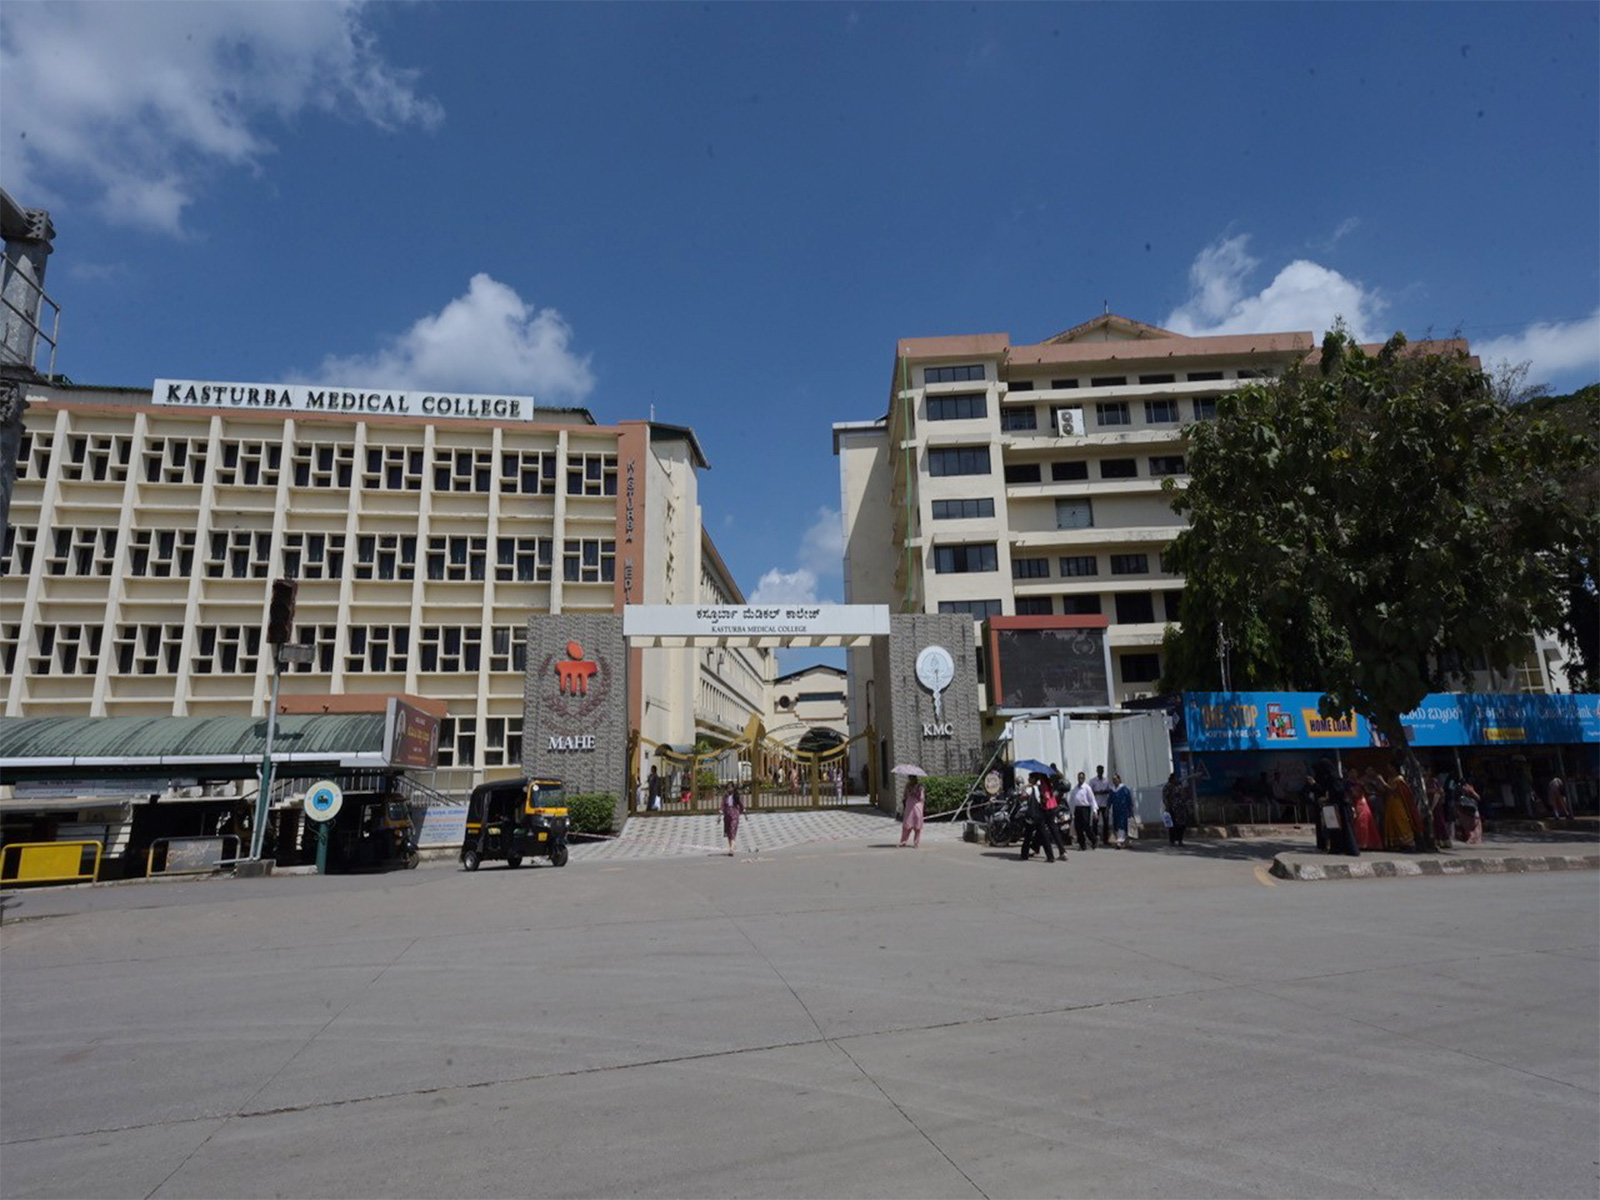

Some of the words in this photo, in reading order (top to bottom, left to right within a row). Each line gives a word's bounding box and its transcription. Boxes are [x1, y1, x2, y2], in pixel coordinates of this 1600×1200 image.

[166, 384, 292, 407] KASTURBA
[306, 390, 409, 412] MEDICAL
[422, 396, 520, 418] COLLEGE
[626, 458, 635, 544] KASTURBA
[624, 555, 633, 605] MEDI
[711, 625, 745, 633] KASTURBA
[747, 625, 776, 633] MEDICAL
[778, 625, 807, 633] COLLEGE
[923, 723, 954, 736] KMC
[1310, 720, 1332, 732] HOME
[548, 735, 596, 750] MAHE
